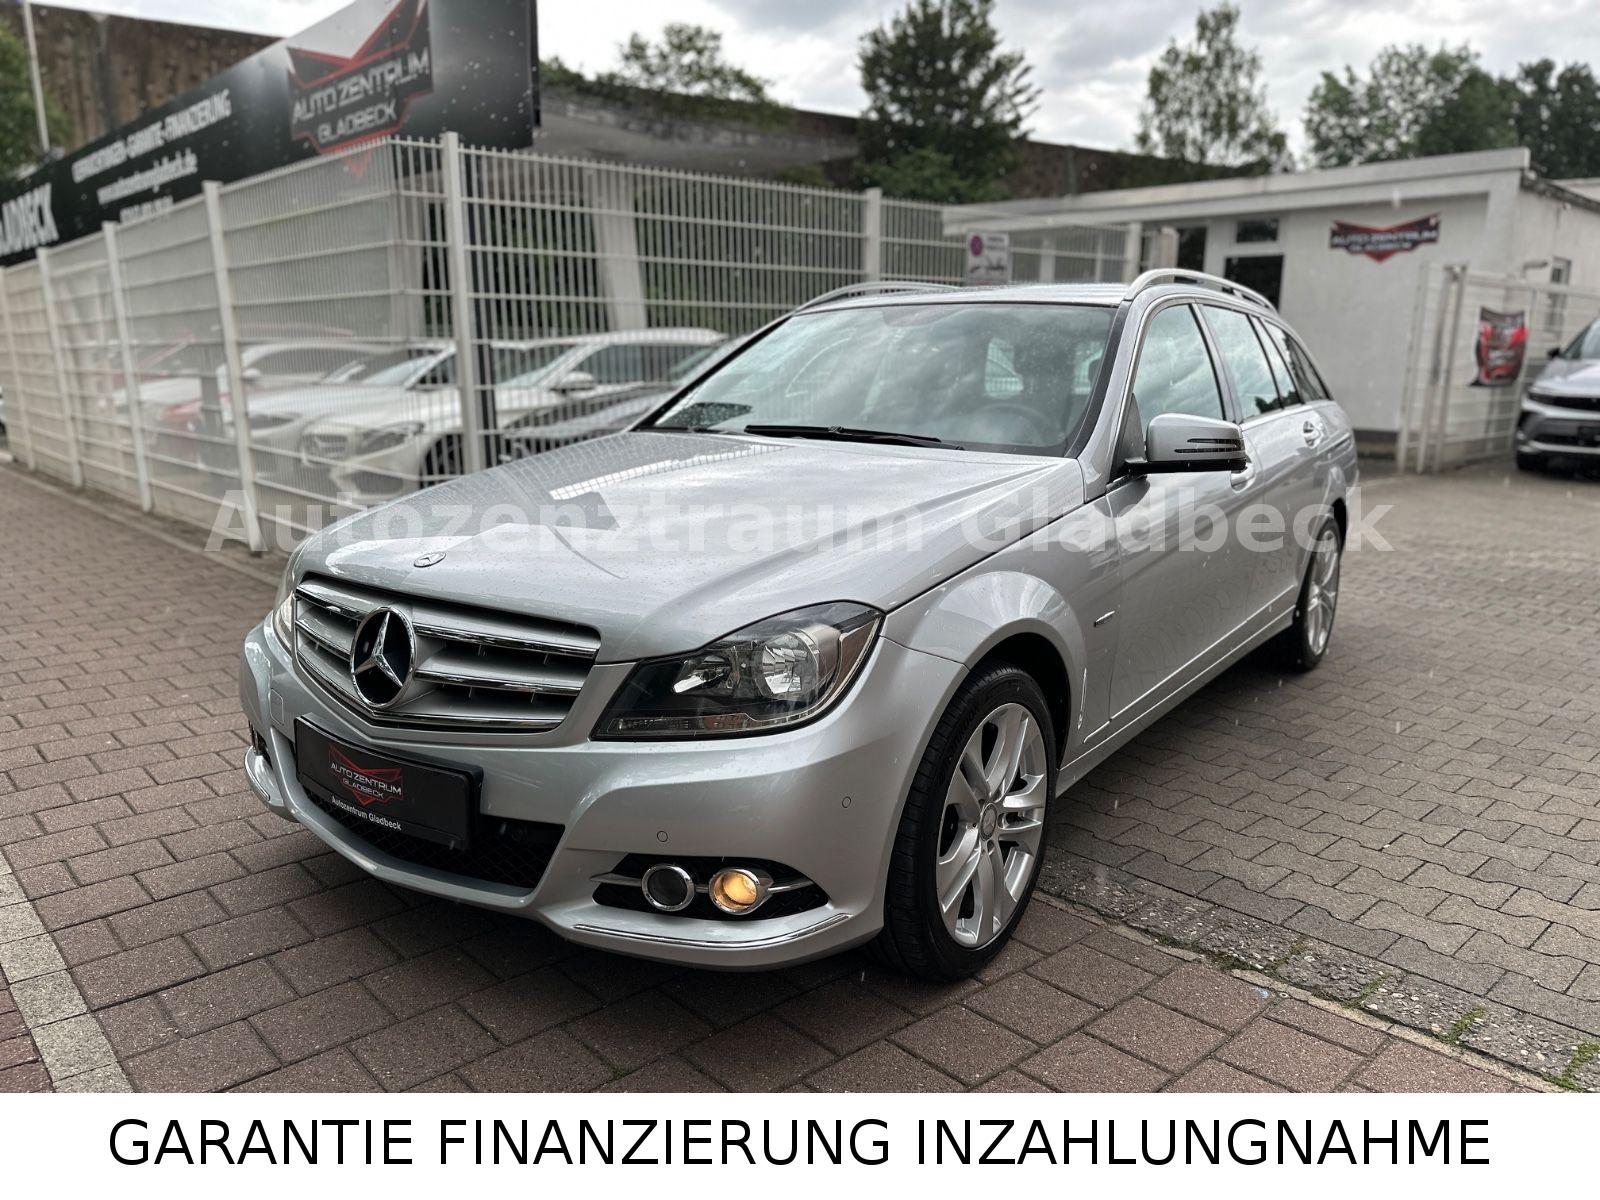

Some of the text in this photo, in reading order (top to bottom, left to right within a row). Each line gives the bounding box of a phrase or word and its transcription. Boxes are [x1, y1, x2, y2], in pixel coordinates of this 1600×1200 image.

[292, 48, 430, 124] AUTO ZENTRUM
[318, 98, 397, 144] GLADBECK
[0, 182, 60, 257] LADBECK
[331, 763, 402, 796] AUTO ZENTRUM
[343, 777, 384, 799] GLADBECK
[332, 796, 402, 830] Autozentrum Gladbeck
